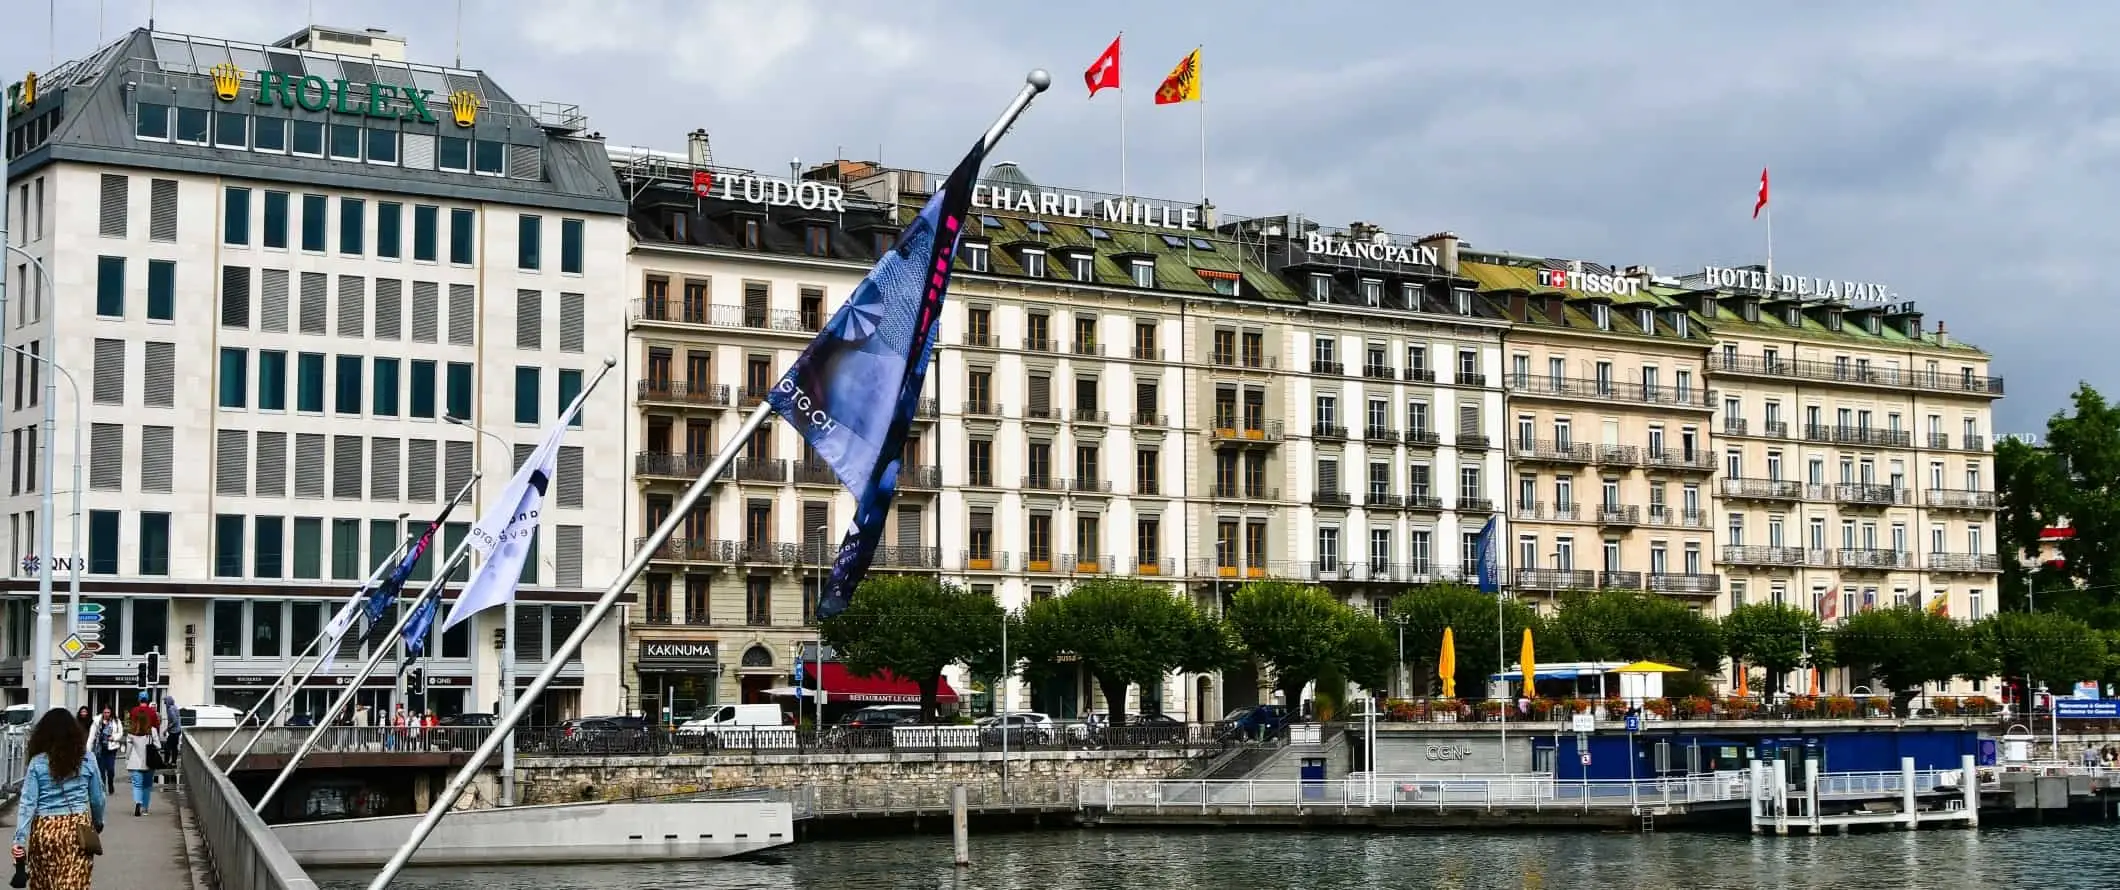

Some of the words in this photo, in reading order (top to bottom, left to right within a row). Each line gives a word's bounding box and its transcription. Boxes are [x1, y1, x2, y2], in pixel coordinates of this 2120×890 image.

[255, 70, 438, 123] ROLEX
[716, 173, 846, 213] TUDOR
[936, 180, 1083, 218] CHARD
[1103, 199, 1197, 231] MILLE
[1305, 231, 1439, 266] BLANCPAIN
[1566, 271, 1641, 297] TISSOT
[1705, 266, 1776, 291] HOTEL
[1780, 275, 1809, 294] DE
[1814, 278, 1838, 298] LA
[1843, 282, 1890, 302] PAIX
[780, 378, 838, 435] GTG.CH
[647, 644, 711, 656] KAKINUMA
[849, 694, 892, 703] RESTAURANT
